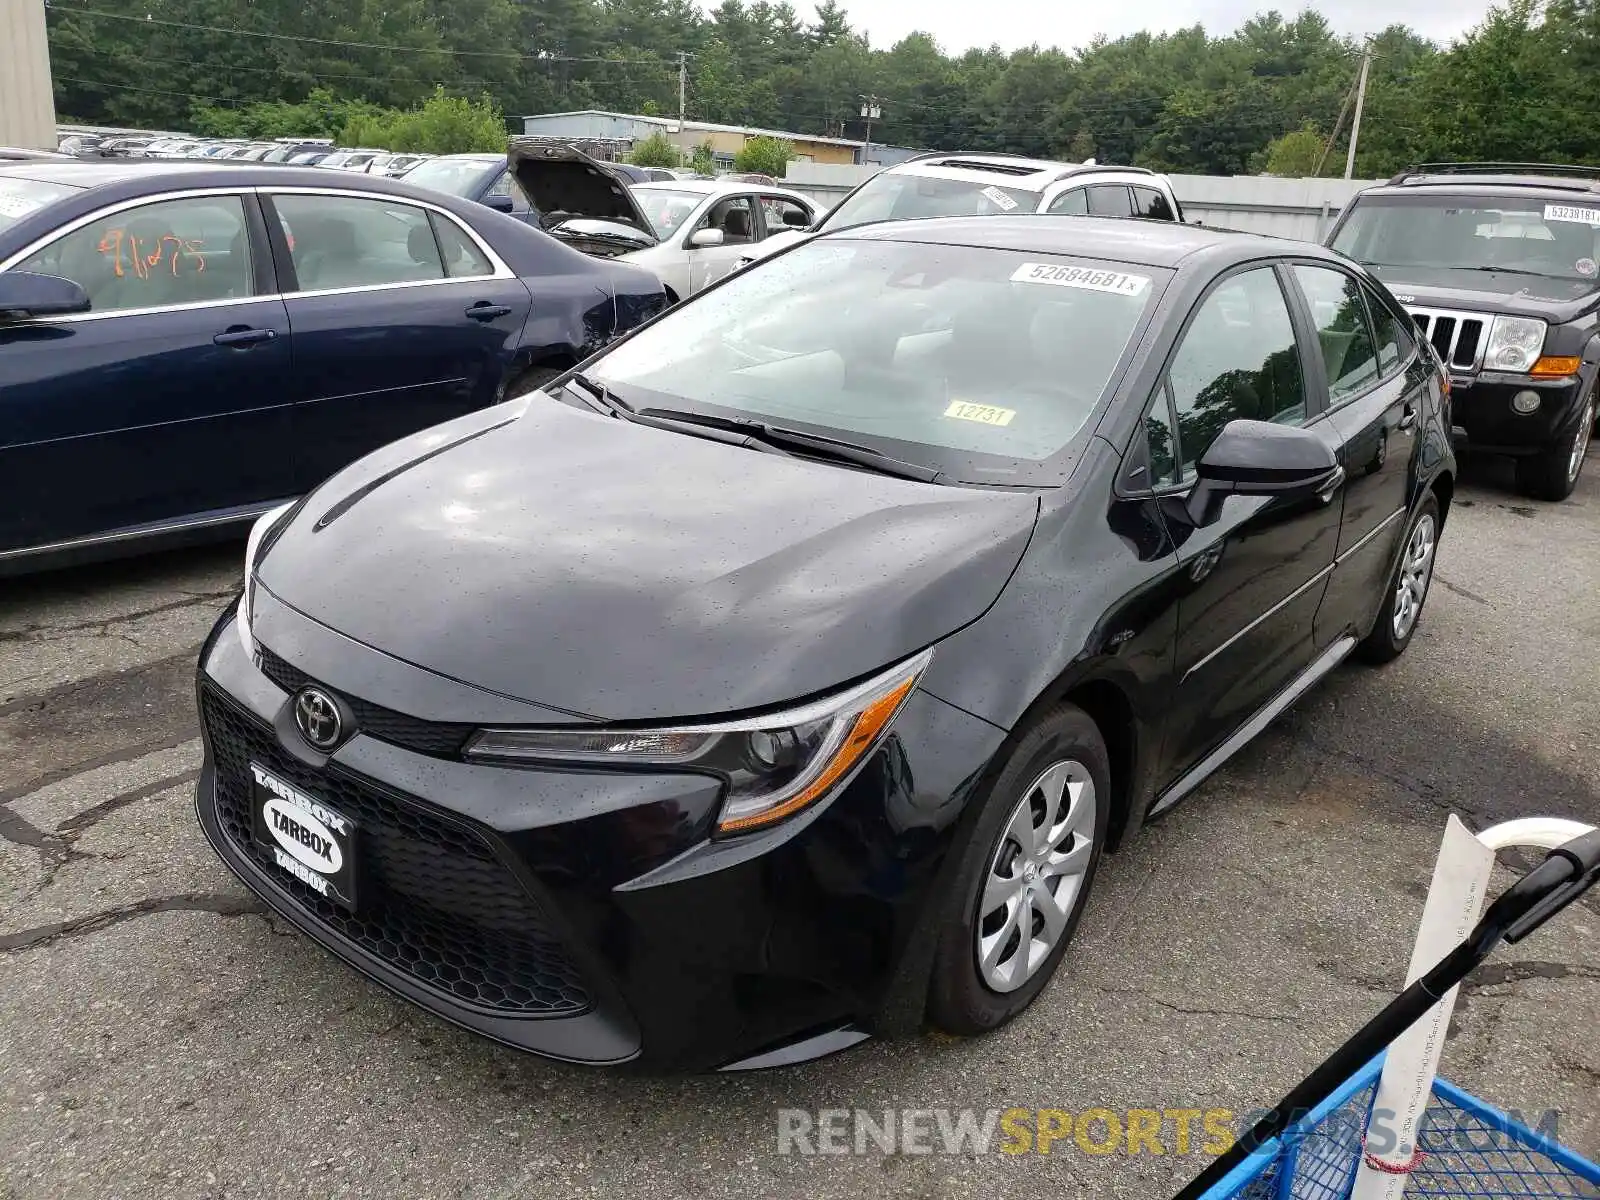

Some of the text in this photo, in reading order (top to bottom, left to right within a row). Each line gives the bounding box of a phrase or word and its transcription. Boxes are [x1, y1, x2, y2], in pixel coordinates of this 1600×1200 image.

[250, 764, 347, 837] TARBOX
[270, 807, 334, 864] TARBOX
[273, 847, 329, 897] TARBOX
